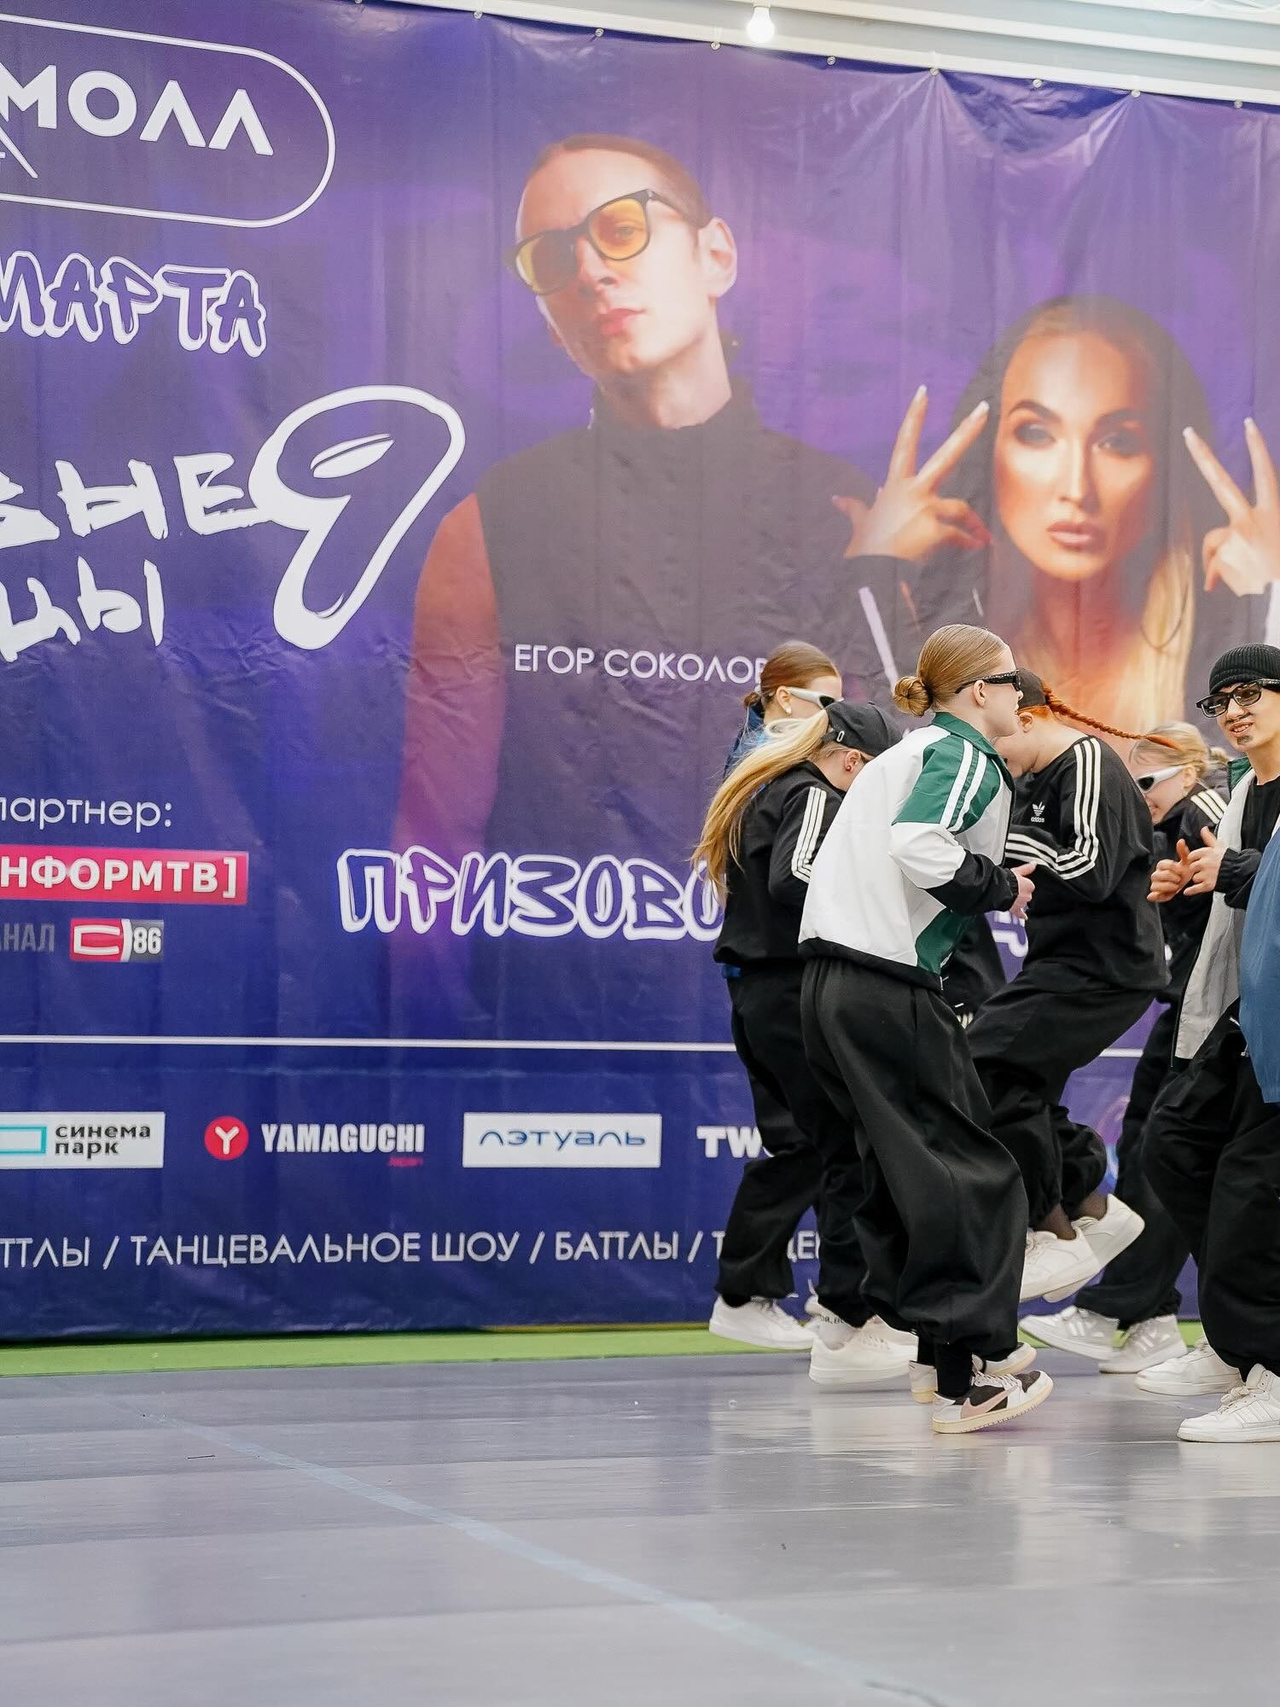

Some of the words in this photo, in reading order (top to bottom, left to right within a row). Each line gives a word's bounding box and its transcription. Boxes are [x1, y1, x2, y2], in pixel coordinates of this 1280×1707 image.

[514, 643, 595, 674] ЕГОР
[0, 922, 55, 953] НАЛ
[55, 1125, 151, 1138] синема
[262, 1124, 425, 1153] YAMAGUCHI
[55, 1142, 118, 1159] парк
[131, 1232, 421, 1268] ТАНЦЕВАЛЬНОЕ
[432, 1232, 519, 1262] ШОУ
[555, 1231, 679, 1261] БАТТЛЫ
